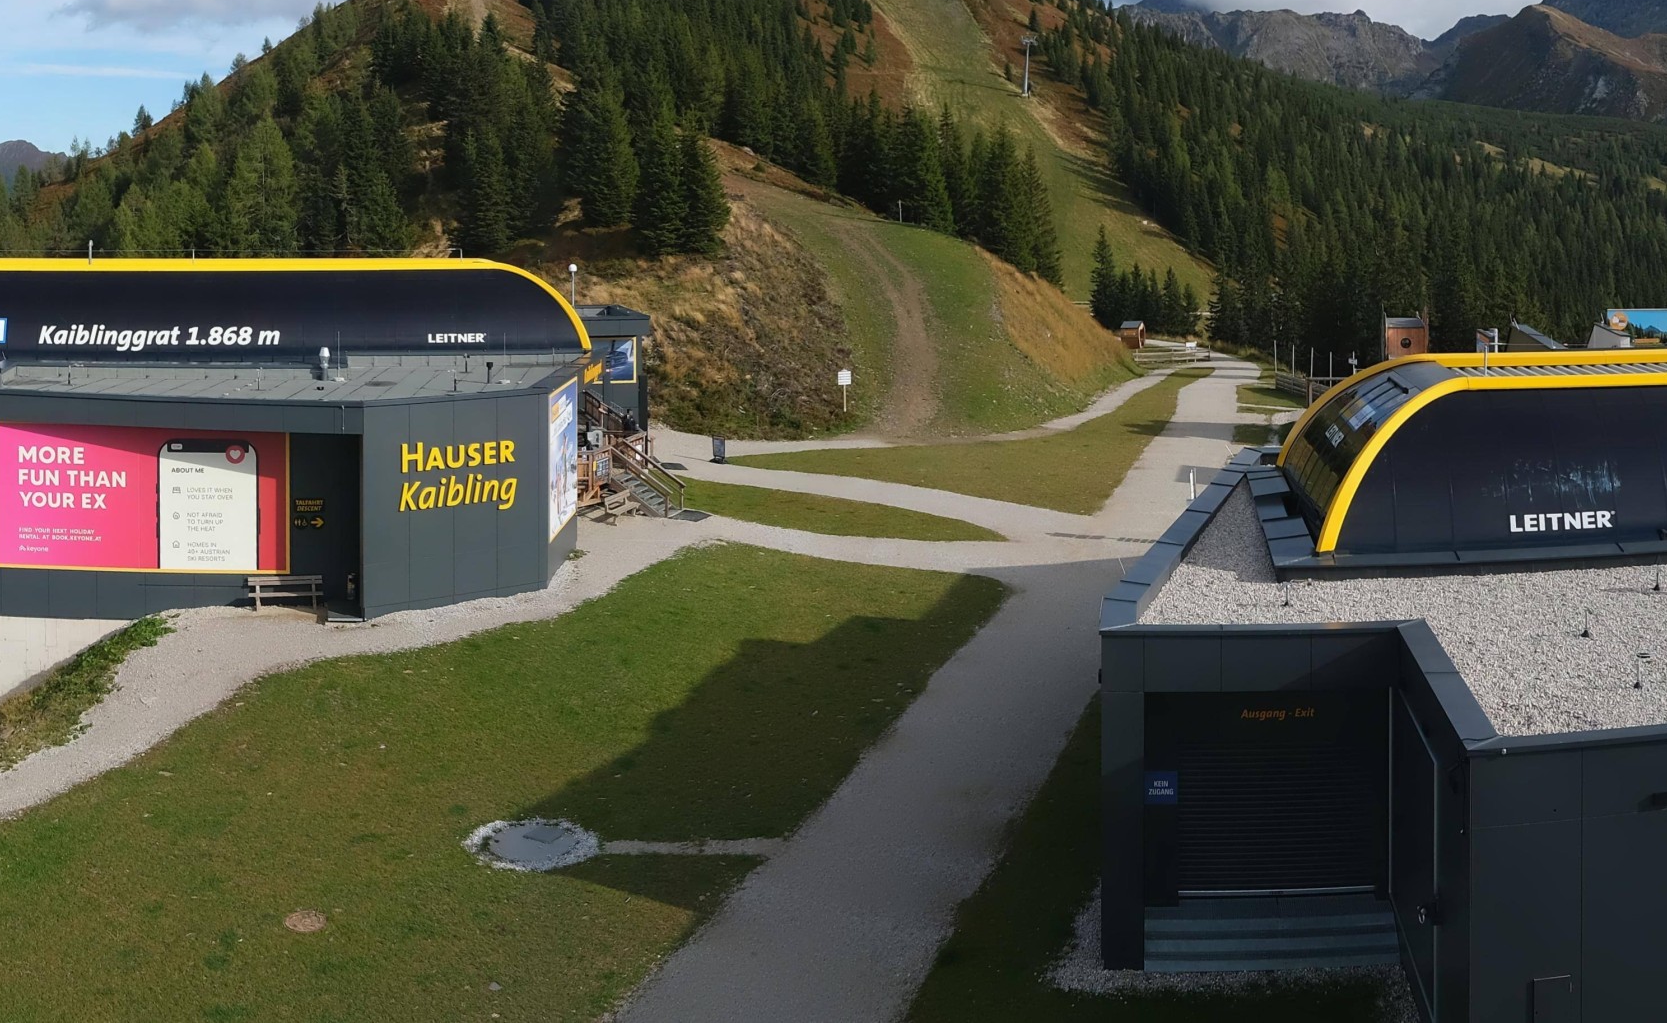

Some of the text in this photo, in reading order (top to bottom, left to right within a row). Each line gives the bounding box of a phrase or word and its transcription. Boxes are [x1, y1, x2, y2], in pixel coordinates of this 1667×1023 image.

[38, 324, 281, 351] Kaiblinggrat 1.868 m
[427, 332, 486, 344] LEITNER
[18, 445, 85, 465] MORE
[401, 440, 516, 473] HAUSER
[18, 469, 127, 488] FUN THAN
[19, 491, 107, 509] YOUR EX
[399, 473, 518, 512] Kaibling
[1509, 511, 1615, 533] LEITNER
[27, 545, 49, 553] keyone
[1240, 708, 1286, 721] Ausgang
[1295, 707, 1315, 718] Exit
[1148, 788, 1174, 796] ZUGANG
[1153, 780, 1169, 788] KEIN
